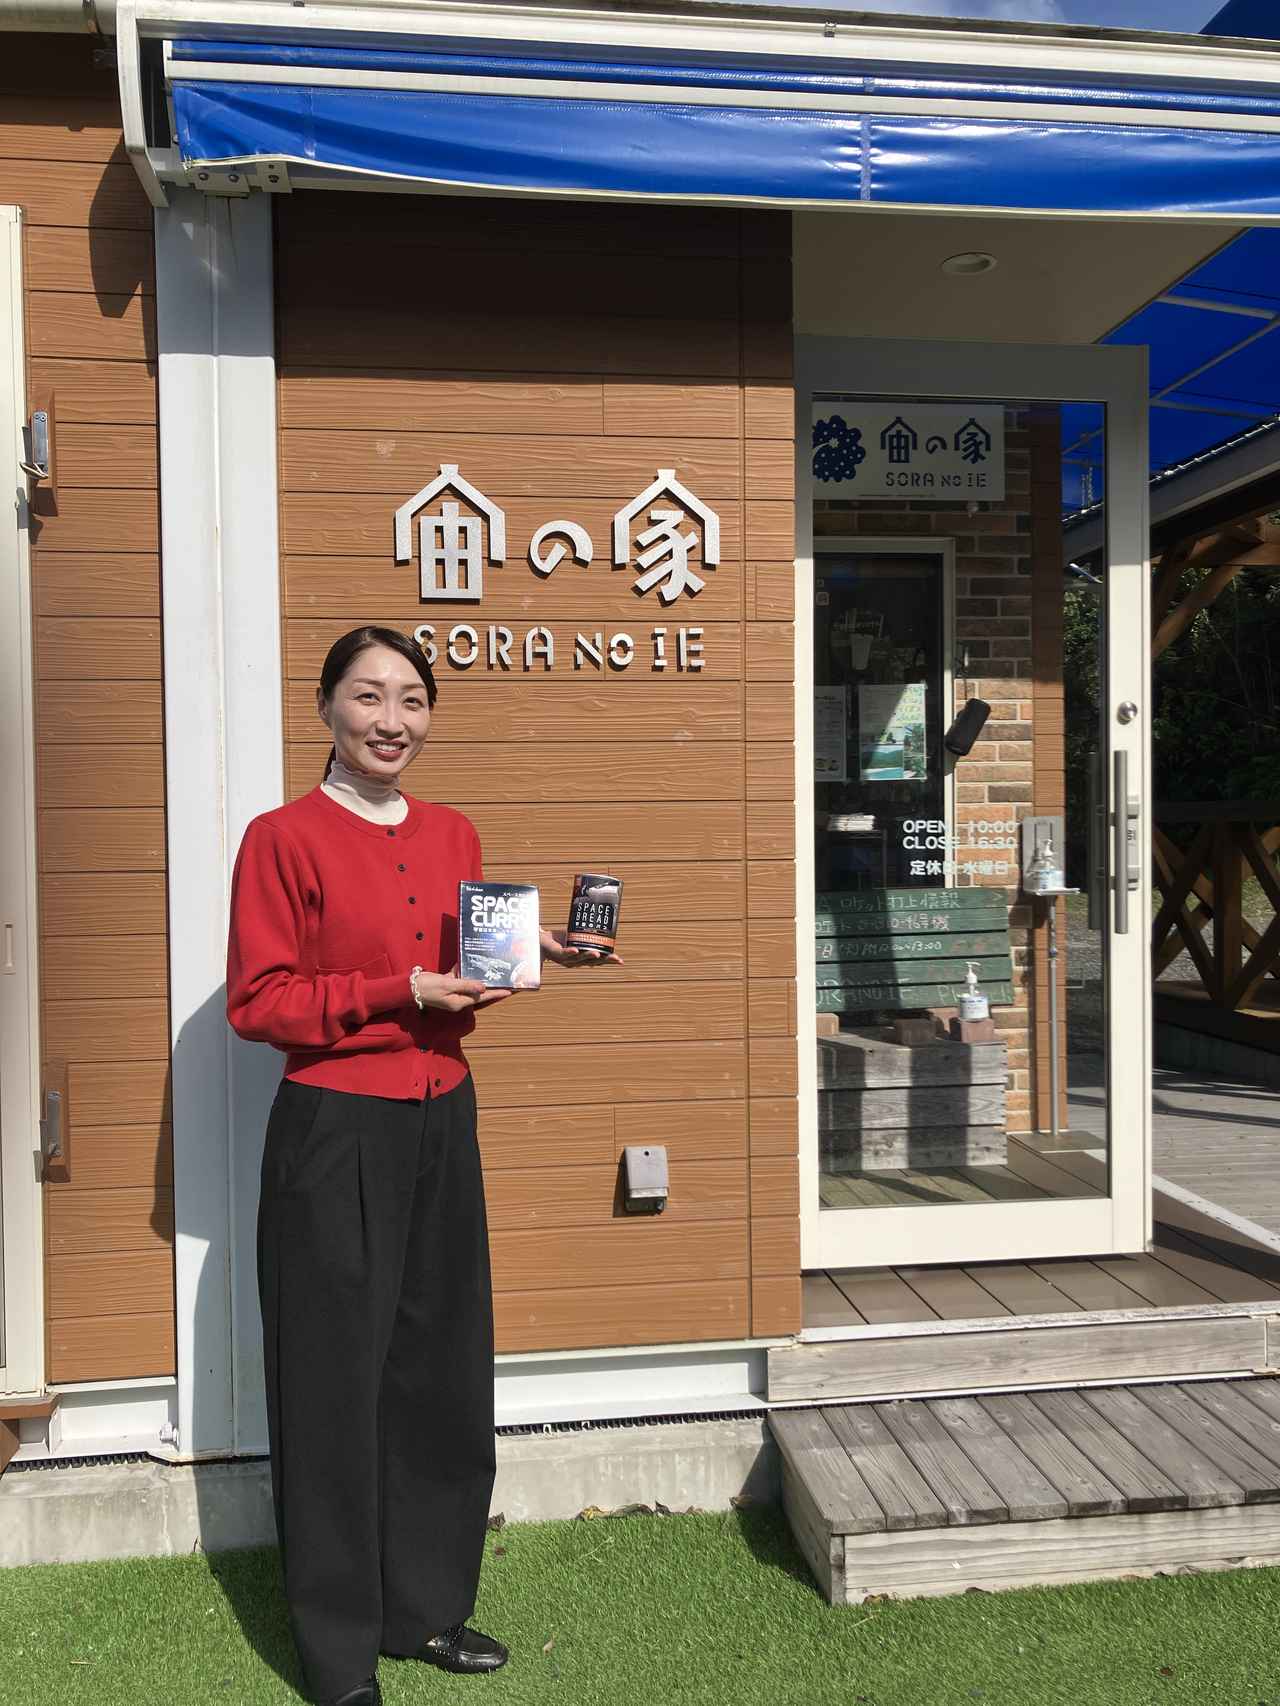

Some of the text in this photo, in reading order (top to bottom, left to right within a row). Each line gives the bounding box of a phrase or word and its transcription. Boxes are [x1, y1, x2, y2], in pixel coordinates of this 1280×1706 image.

[886, 472, 935, 487] SORA
[967, 473, 987, 487] IE
[413, 624, 554, 666] SORA
[654, 627, 706, 666] IE
[966, 820, 1017, 834] 10:00
[966, 836, 1018, 850] 16:30
[470, 895, 530, 913] SPACE
[577, 902, 610, 916] SPACE
[575, 911, 609, 925] BREAD
